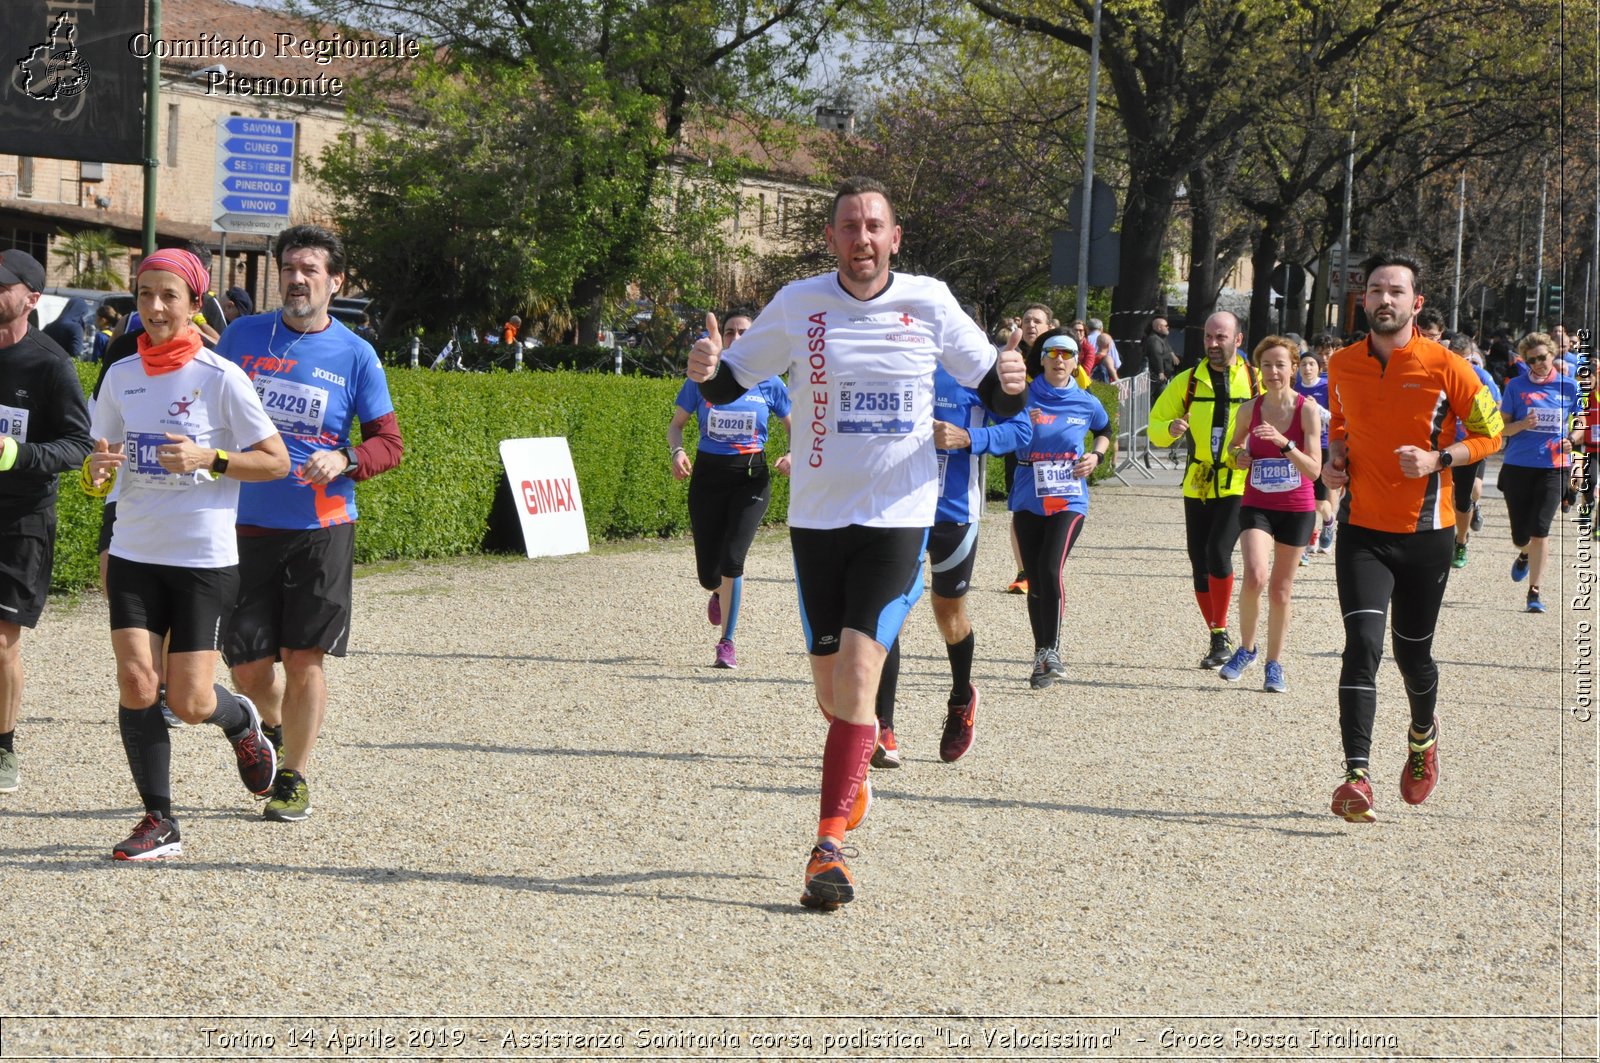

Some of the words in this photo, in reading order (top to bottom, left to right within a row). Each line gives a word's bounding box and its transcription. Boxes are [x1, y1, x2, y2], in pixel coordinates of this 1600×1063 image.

[242, 123, 282, 135] SAVONA
[244, 142, 278, 153] CUNEO
[234, 160, 286, 173] SESTRIERE
[235, 180, 282, 192] PINEROLO
[241, 199, 276, 211] VINOVO
[807, 311, 827, 385] ROSSA
[266, 391, 307, 415] 2429
[854, 391, 900, 411] 2535
[718, 418, 744, 430] 2020
[809, 391, 828, 468] CROCE
[1262, 466, 1288, 479] 1286
[521, 478, 577, 515] GIMAX
[838, 737, 874, 812] Kalenji
